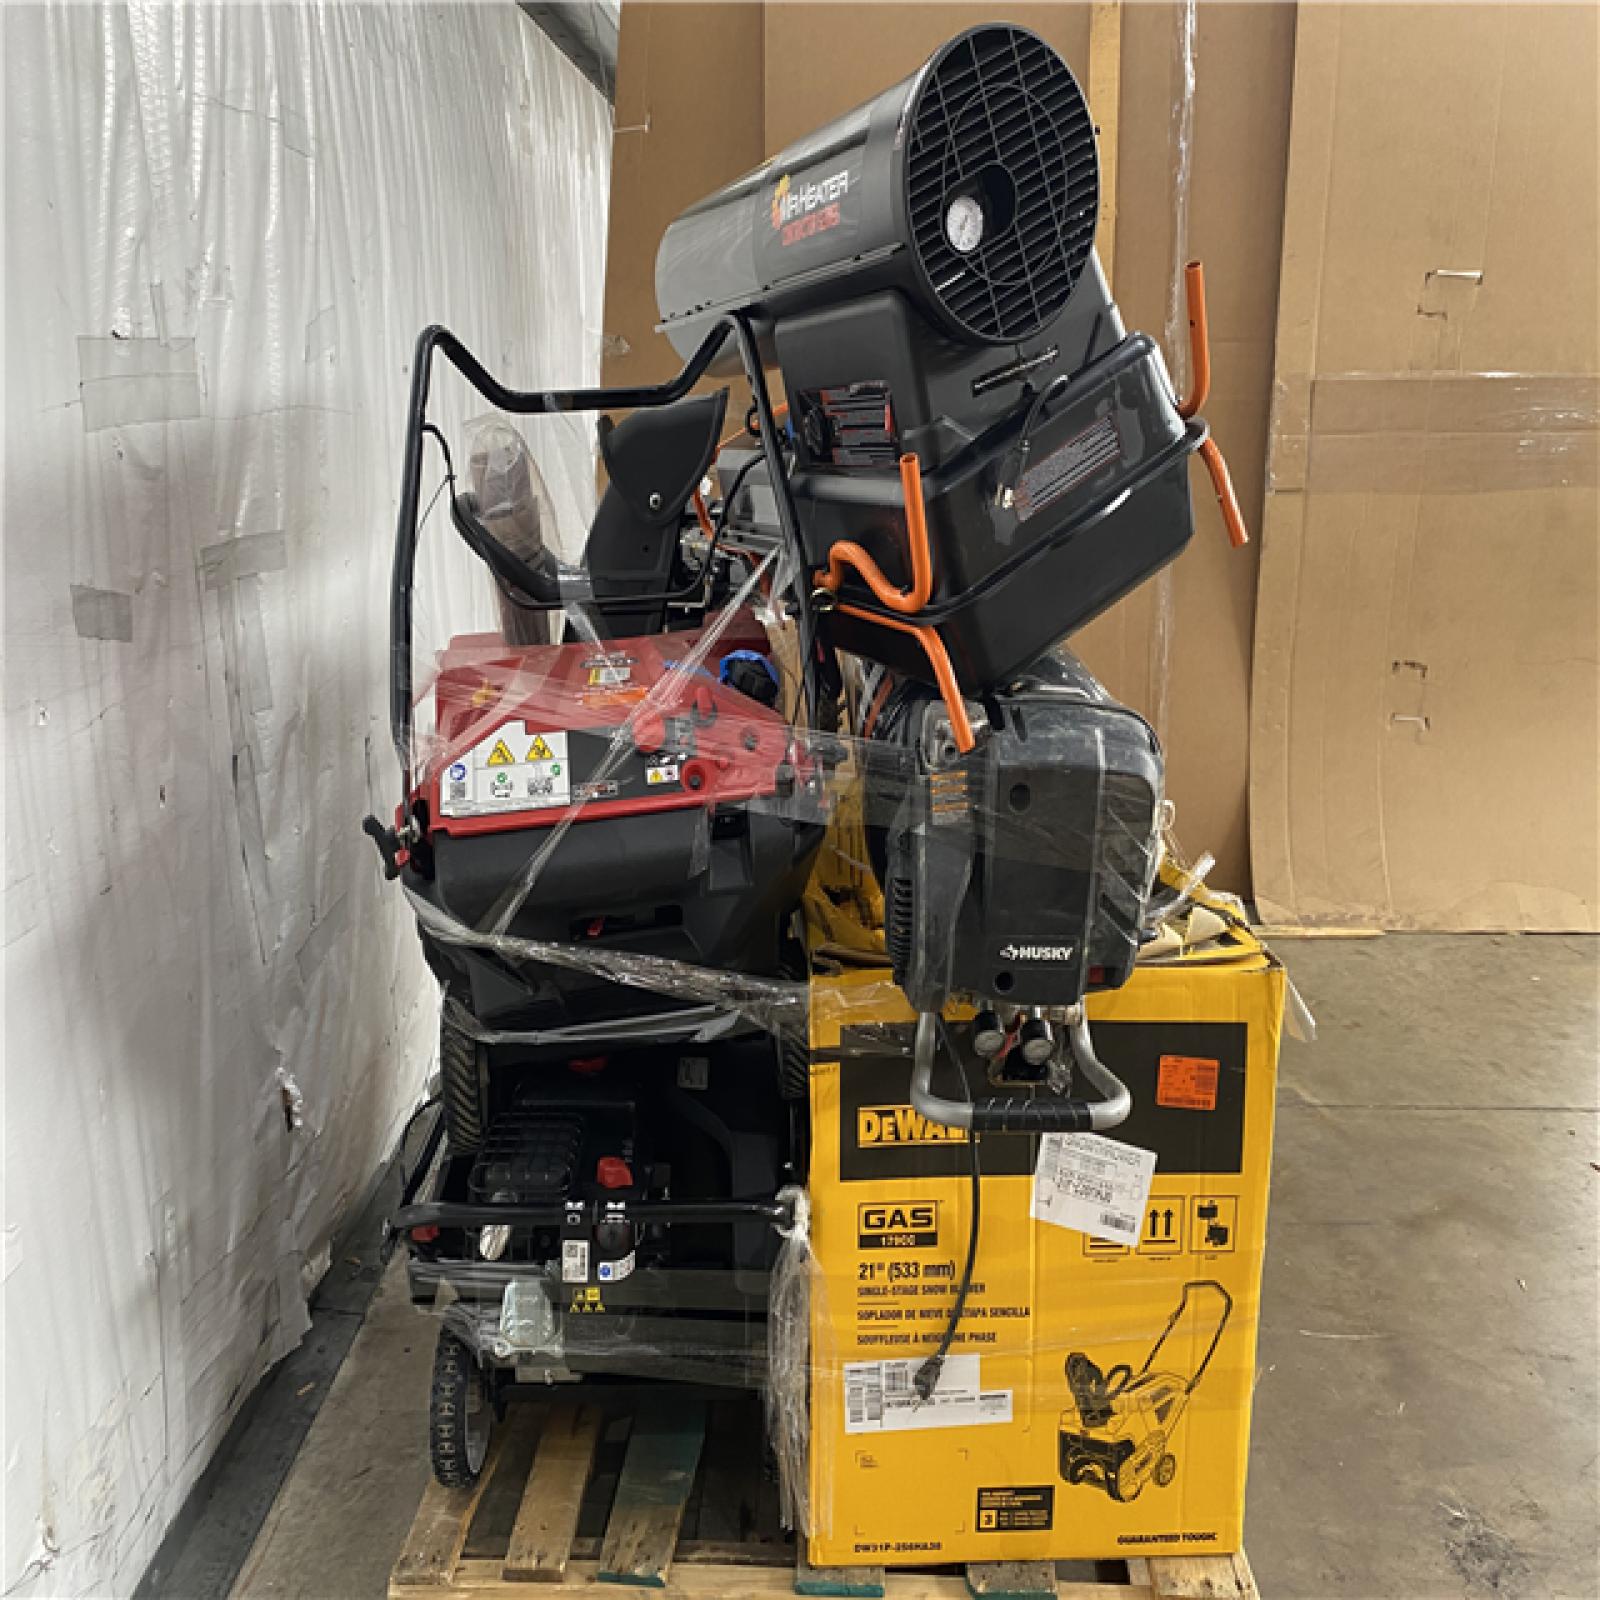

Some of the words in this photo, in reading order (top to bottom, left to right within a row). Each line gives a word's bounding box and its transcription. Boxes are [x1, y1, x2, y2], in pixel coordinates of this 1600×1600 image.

[1019, 946, 1074, 961] HUSKY
[859, 1109, 969, 1141] DEWA
[864, 1207, 933, 1229] GAS
[888, 1261, 920, 1283] (533
[922, 1260, 956, 1281] mm)
[857, 1285, 918, 1297] SINGLE-STAGE
[922, 1284, 946, 1296] SNOW
[949, 1283, 986, 1295] BLWER
[969, 1331, 996, 1343] PHASE
